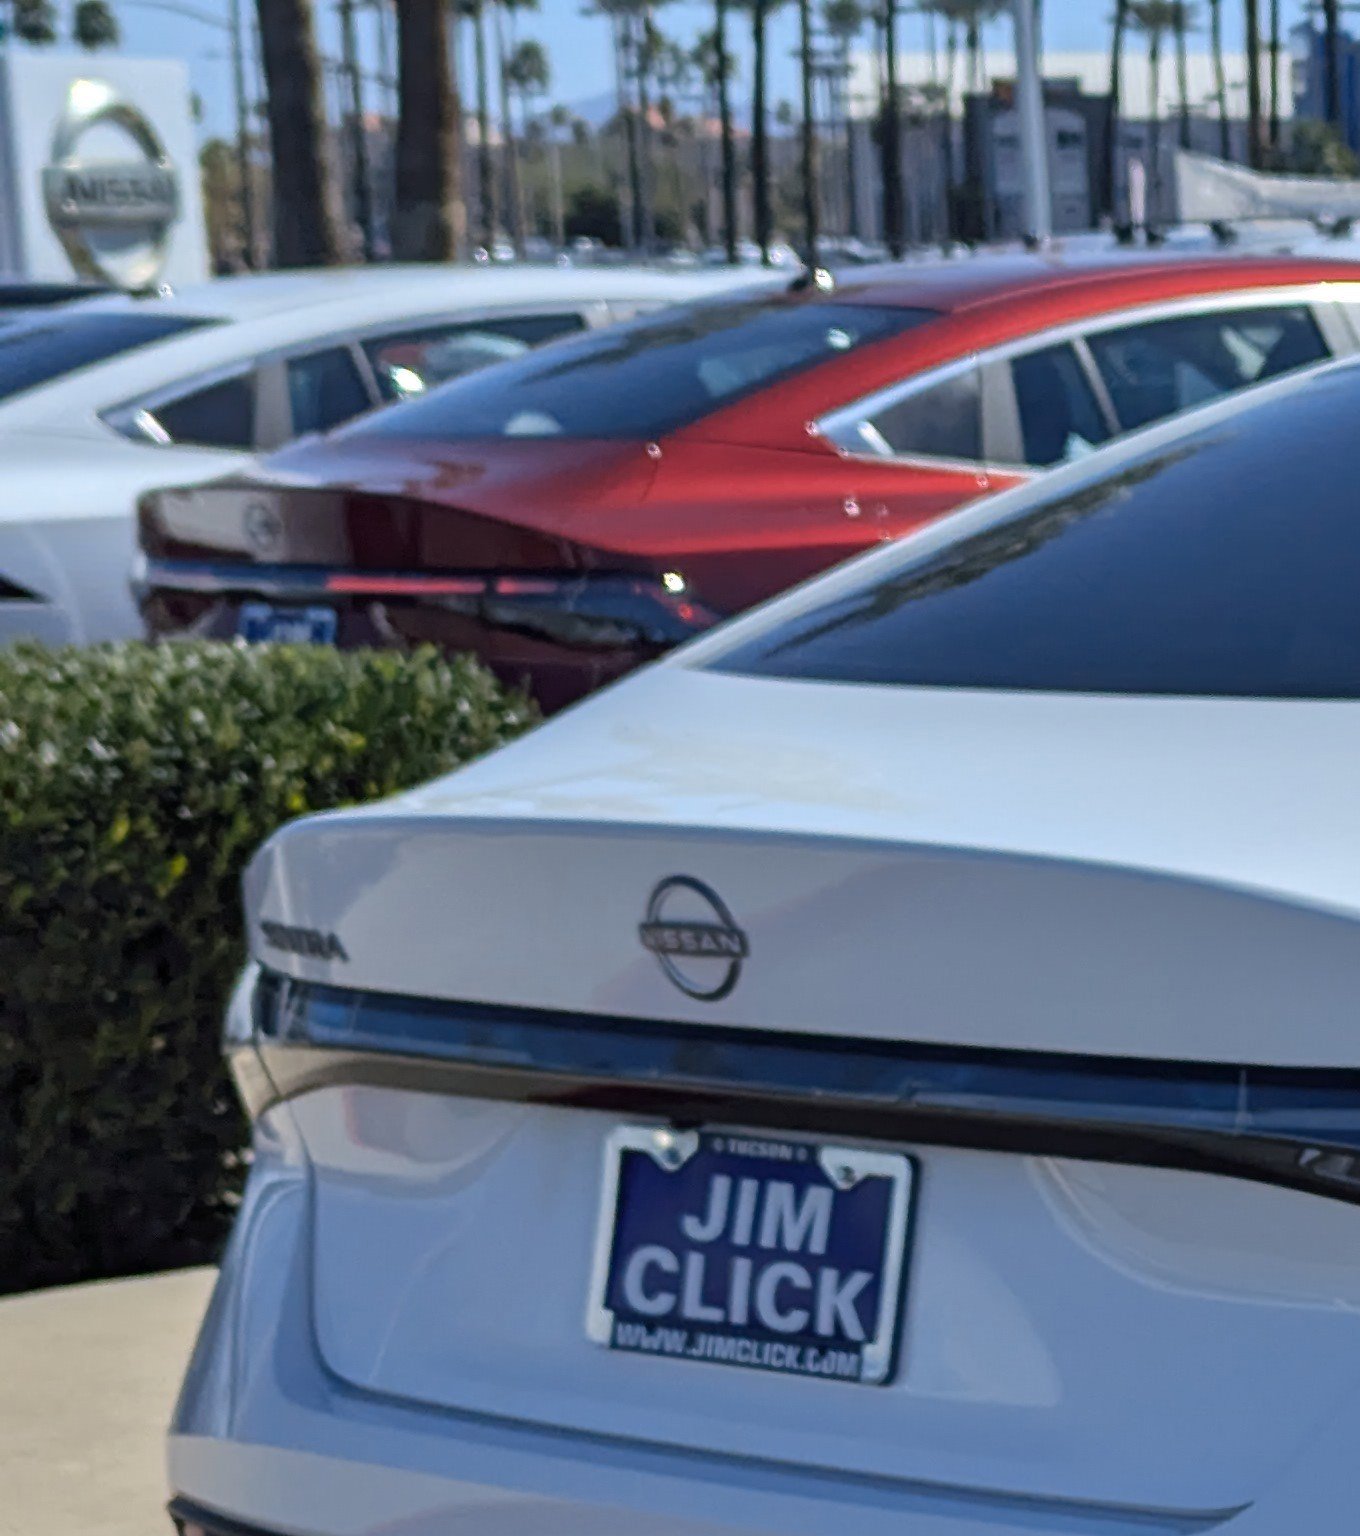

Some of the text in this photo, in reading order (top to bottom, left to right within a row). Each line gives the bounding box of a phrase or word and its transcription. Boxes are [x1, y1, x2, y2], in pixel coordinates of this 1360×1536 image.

[641, 926, 742, 955] NISSAN
[679, 1174, 834, 1256] JIM
[623, 1244, 874, 1342] CLICK
